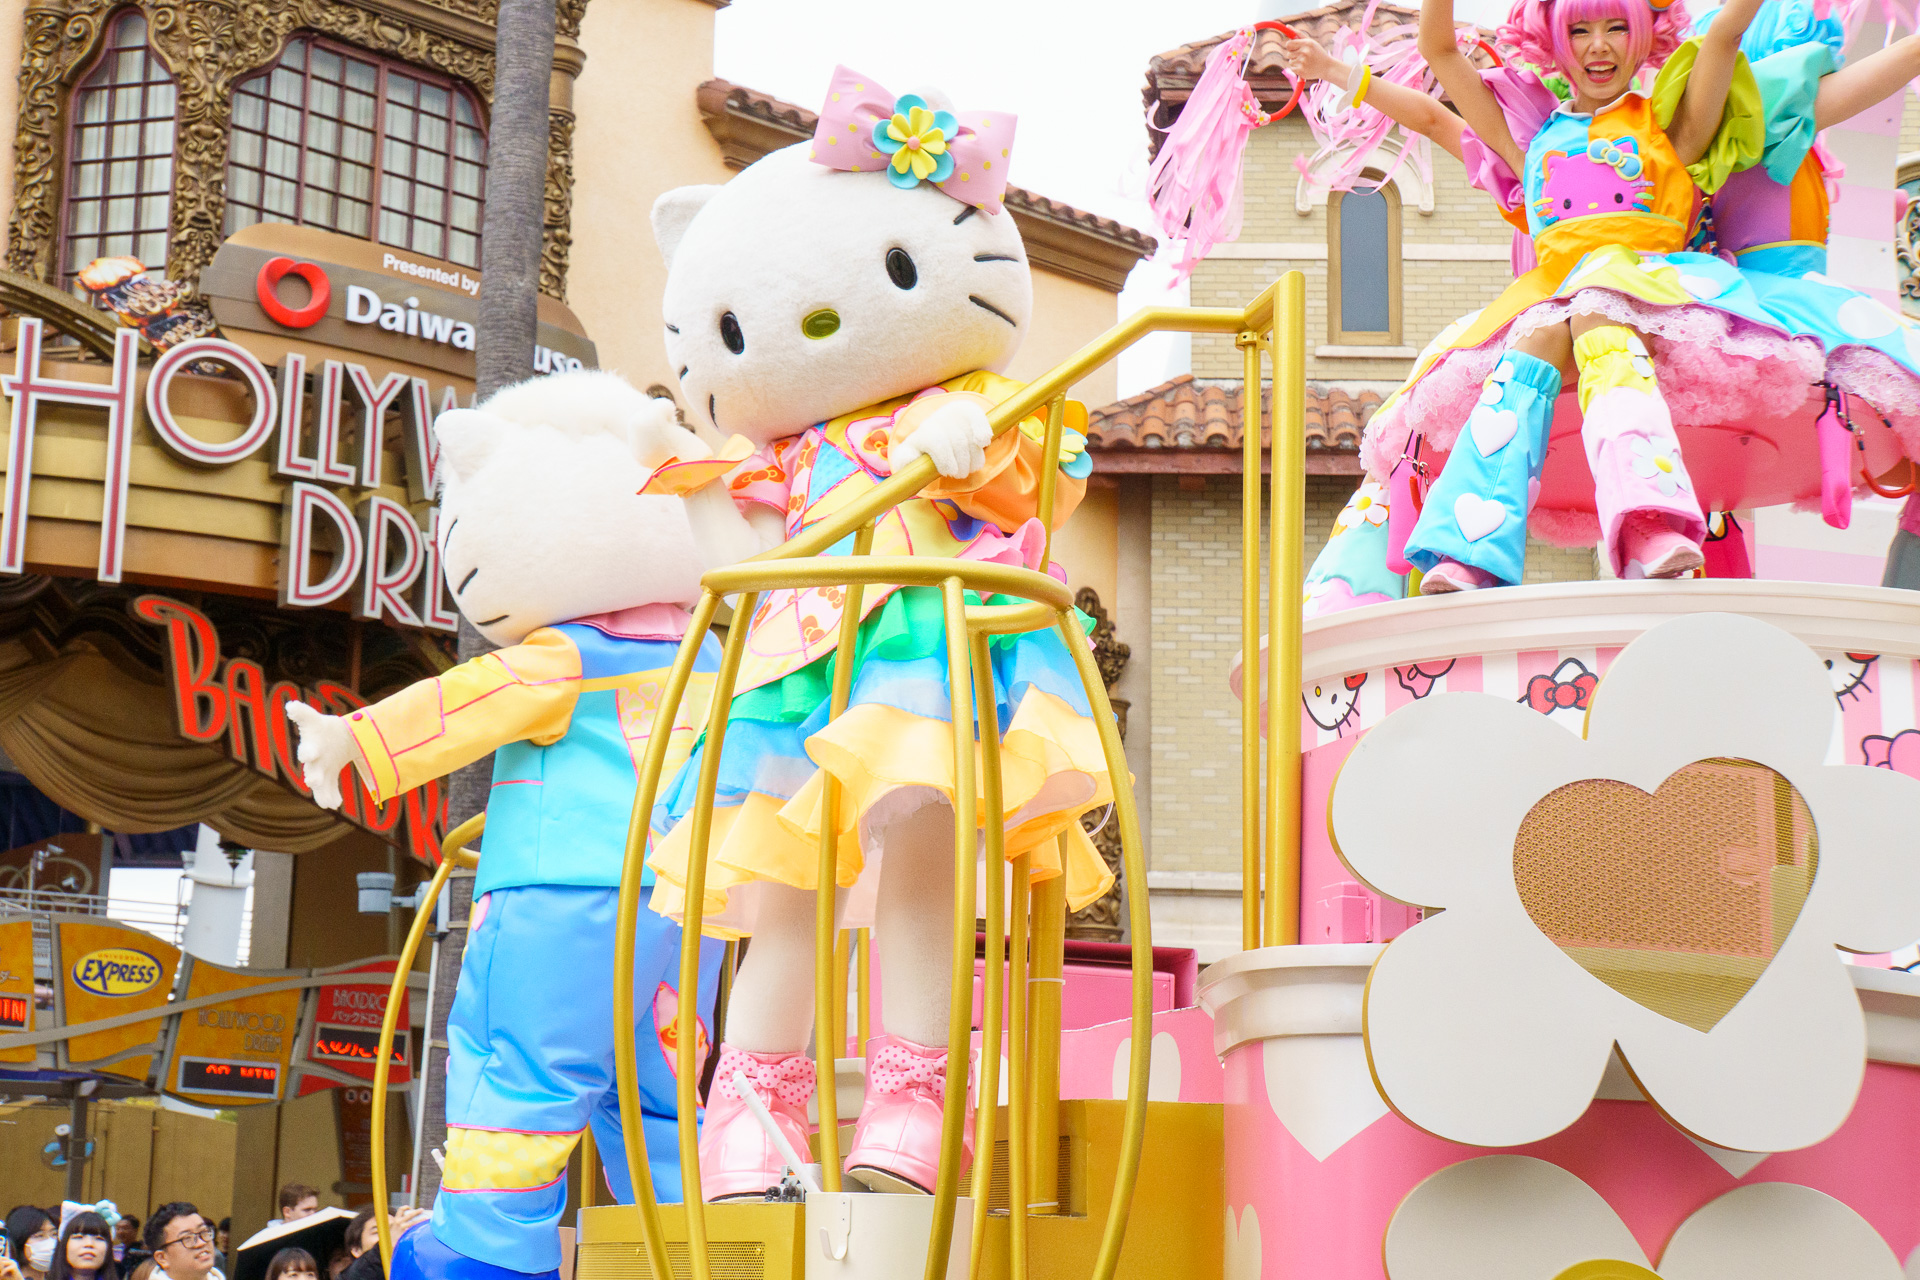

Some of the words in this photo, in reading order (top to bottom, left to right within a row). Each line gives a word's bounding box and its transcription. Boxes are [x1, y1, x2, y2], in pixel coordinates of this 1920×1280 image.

[383, 253, 459, 288] Presented
[461, 272, 481, 296] by
[346, 284, 477, 351] Daiwa
[533, 345, 584, 374] use
[1, 317, 476, 583] HOLLYW
[287, 481, 459, 633] DRE
[81, 959, 156, 991] EXPRESS
[333, 989, 390, 1012] BACKDRO
[198, 1007, 286, 1033] HOLLYWOOD
[243, 1032, 282, 1053] DREAM
